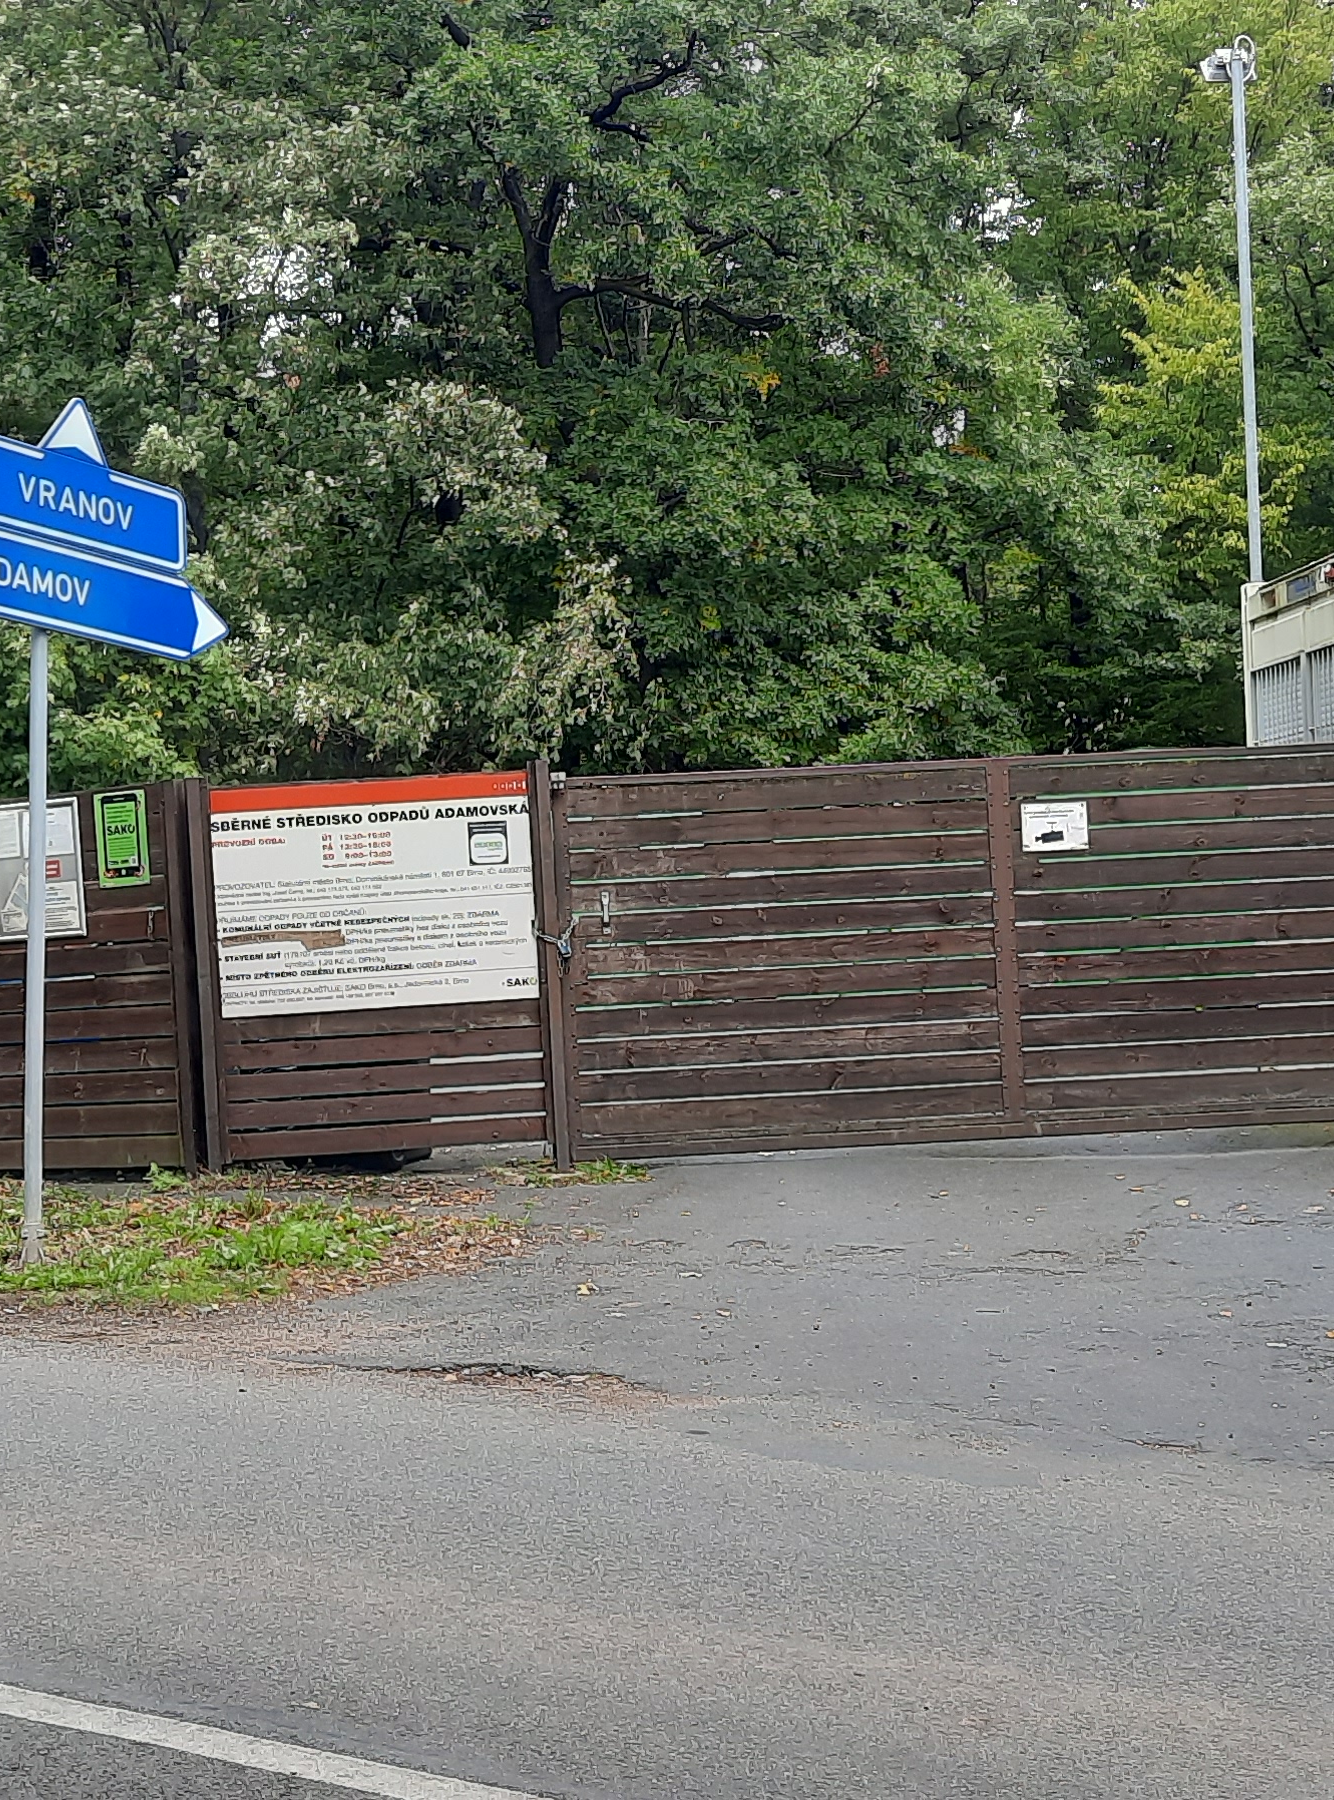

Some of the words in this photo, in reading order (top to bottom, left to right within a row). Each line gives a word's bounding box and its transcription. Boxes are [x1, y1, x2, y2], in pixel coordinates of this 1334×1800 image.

[17, 470, 134, 531] VRANOV
[210, 815, 272, 833] SBĚRNÉ
[276, 812, 363, 829] STŘEDISKO
[367, 805, 430, 824] ODPADŮ
[434, 800, 530, 820] ADAMOVSKÁ
[106, 823, 136, 836] SAKO
[506, 976, 538, 988] SAKO
